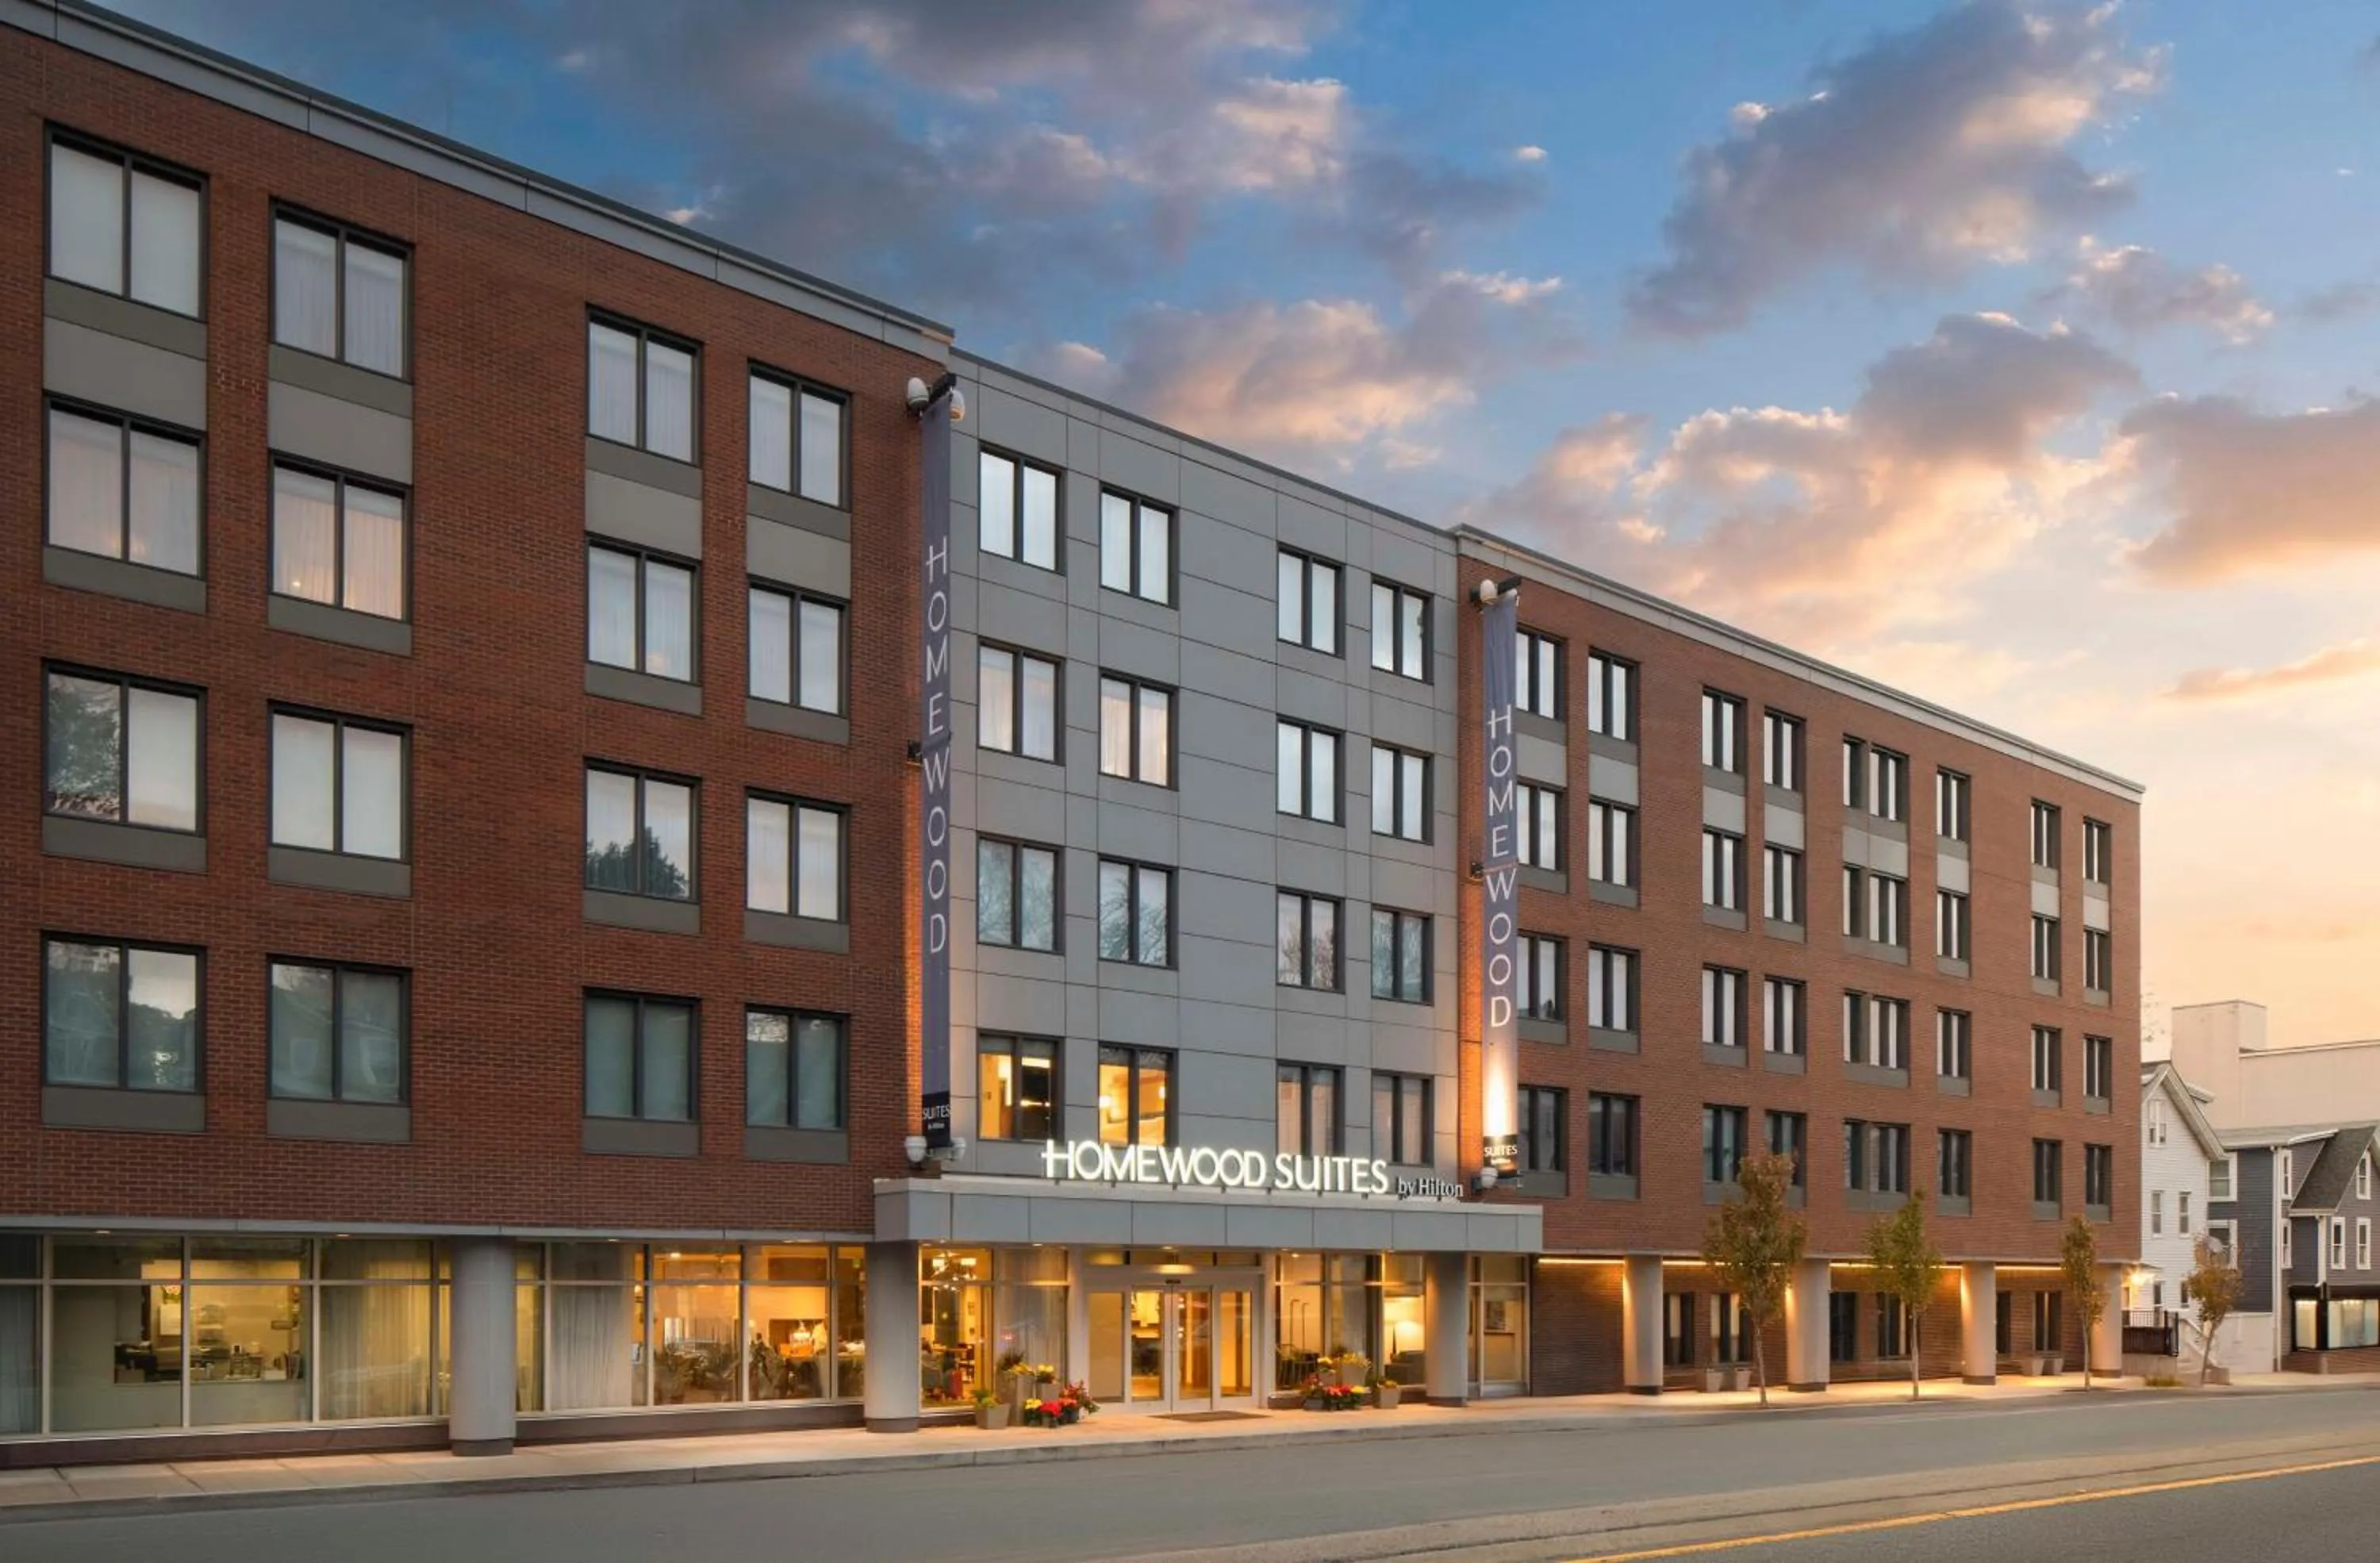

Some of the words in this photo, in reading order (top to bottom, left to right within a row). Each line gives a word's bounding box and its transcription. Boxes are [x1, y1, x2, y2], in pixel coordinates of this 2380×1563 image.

[923, 536, 950, 954] HOMEWOOD
[1486, 703, 1517, 1028] HOMEWOOD
[923, 1104, 950, 1120] SUITES
[1041, 1139, 1267, 1187] HOMEWOOD
[1274, 1153, 1389, 1194] SUITES
[1398, 1175, 1416, 1198] by
[1419, 1177, 1464, 1197] Hilton
[1484, 1144, 1518, 1158] SUITES
